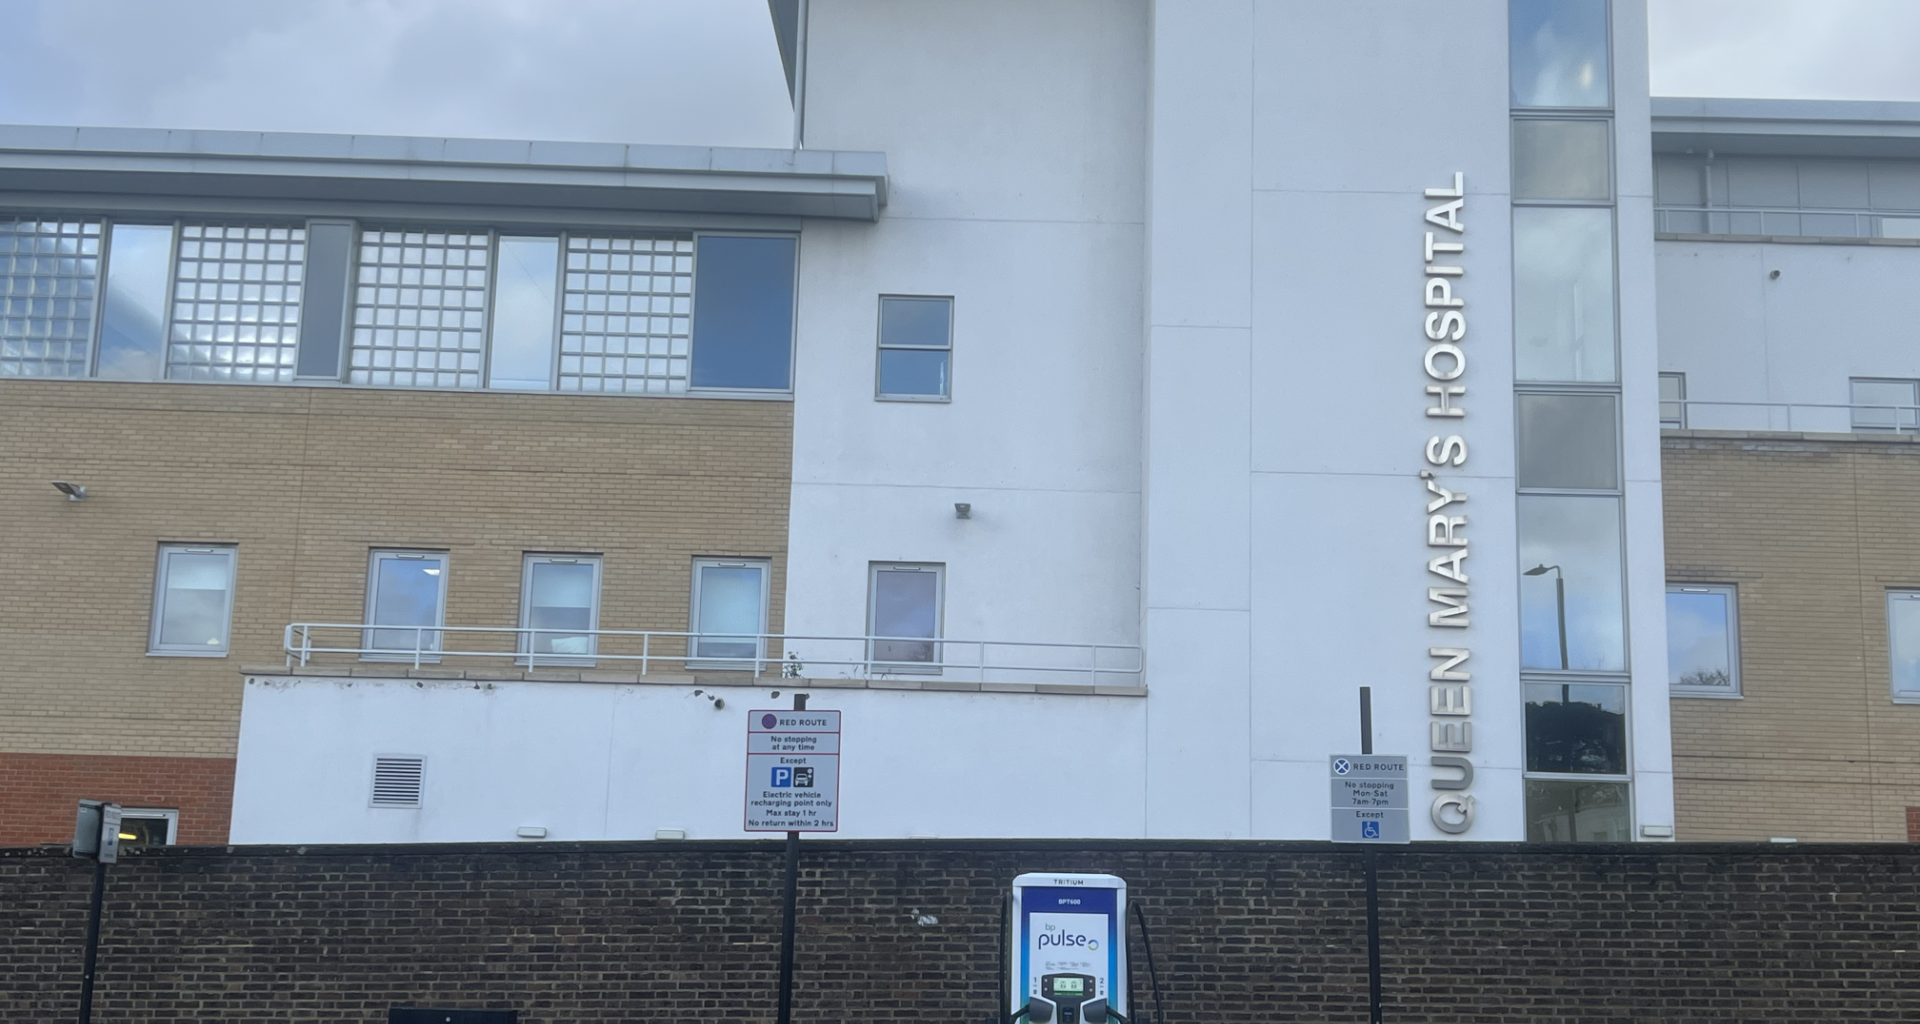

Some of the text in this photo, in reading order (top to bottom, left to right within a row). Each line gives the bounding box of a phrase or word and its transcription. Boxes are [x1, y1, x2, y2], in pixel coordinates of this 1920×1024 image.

[1420, 171, 1476, 834] QUEEN MARY'S HOSPITAL
[784, 736, 817, 744] stopping
[1353, 763, 1404, 771] RED ROUTE
[776, 769, 789, 786] P
[1359, 782, 1394, 790] stopping
[750, 800, 792, 808] recharging
[794, 800, 814, 808] point
[1352, 798, 1388, 806] 7am-7pm
[784, 810, 800, 818] stay
[1356, 810, 1384, 818] Except
[1045, 923, 1056, 932] bp
[1038, 929, 1086, 950] pulse
